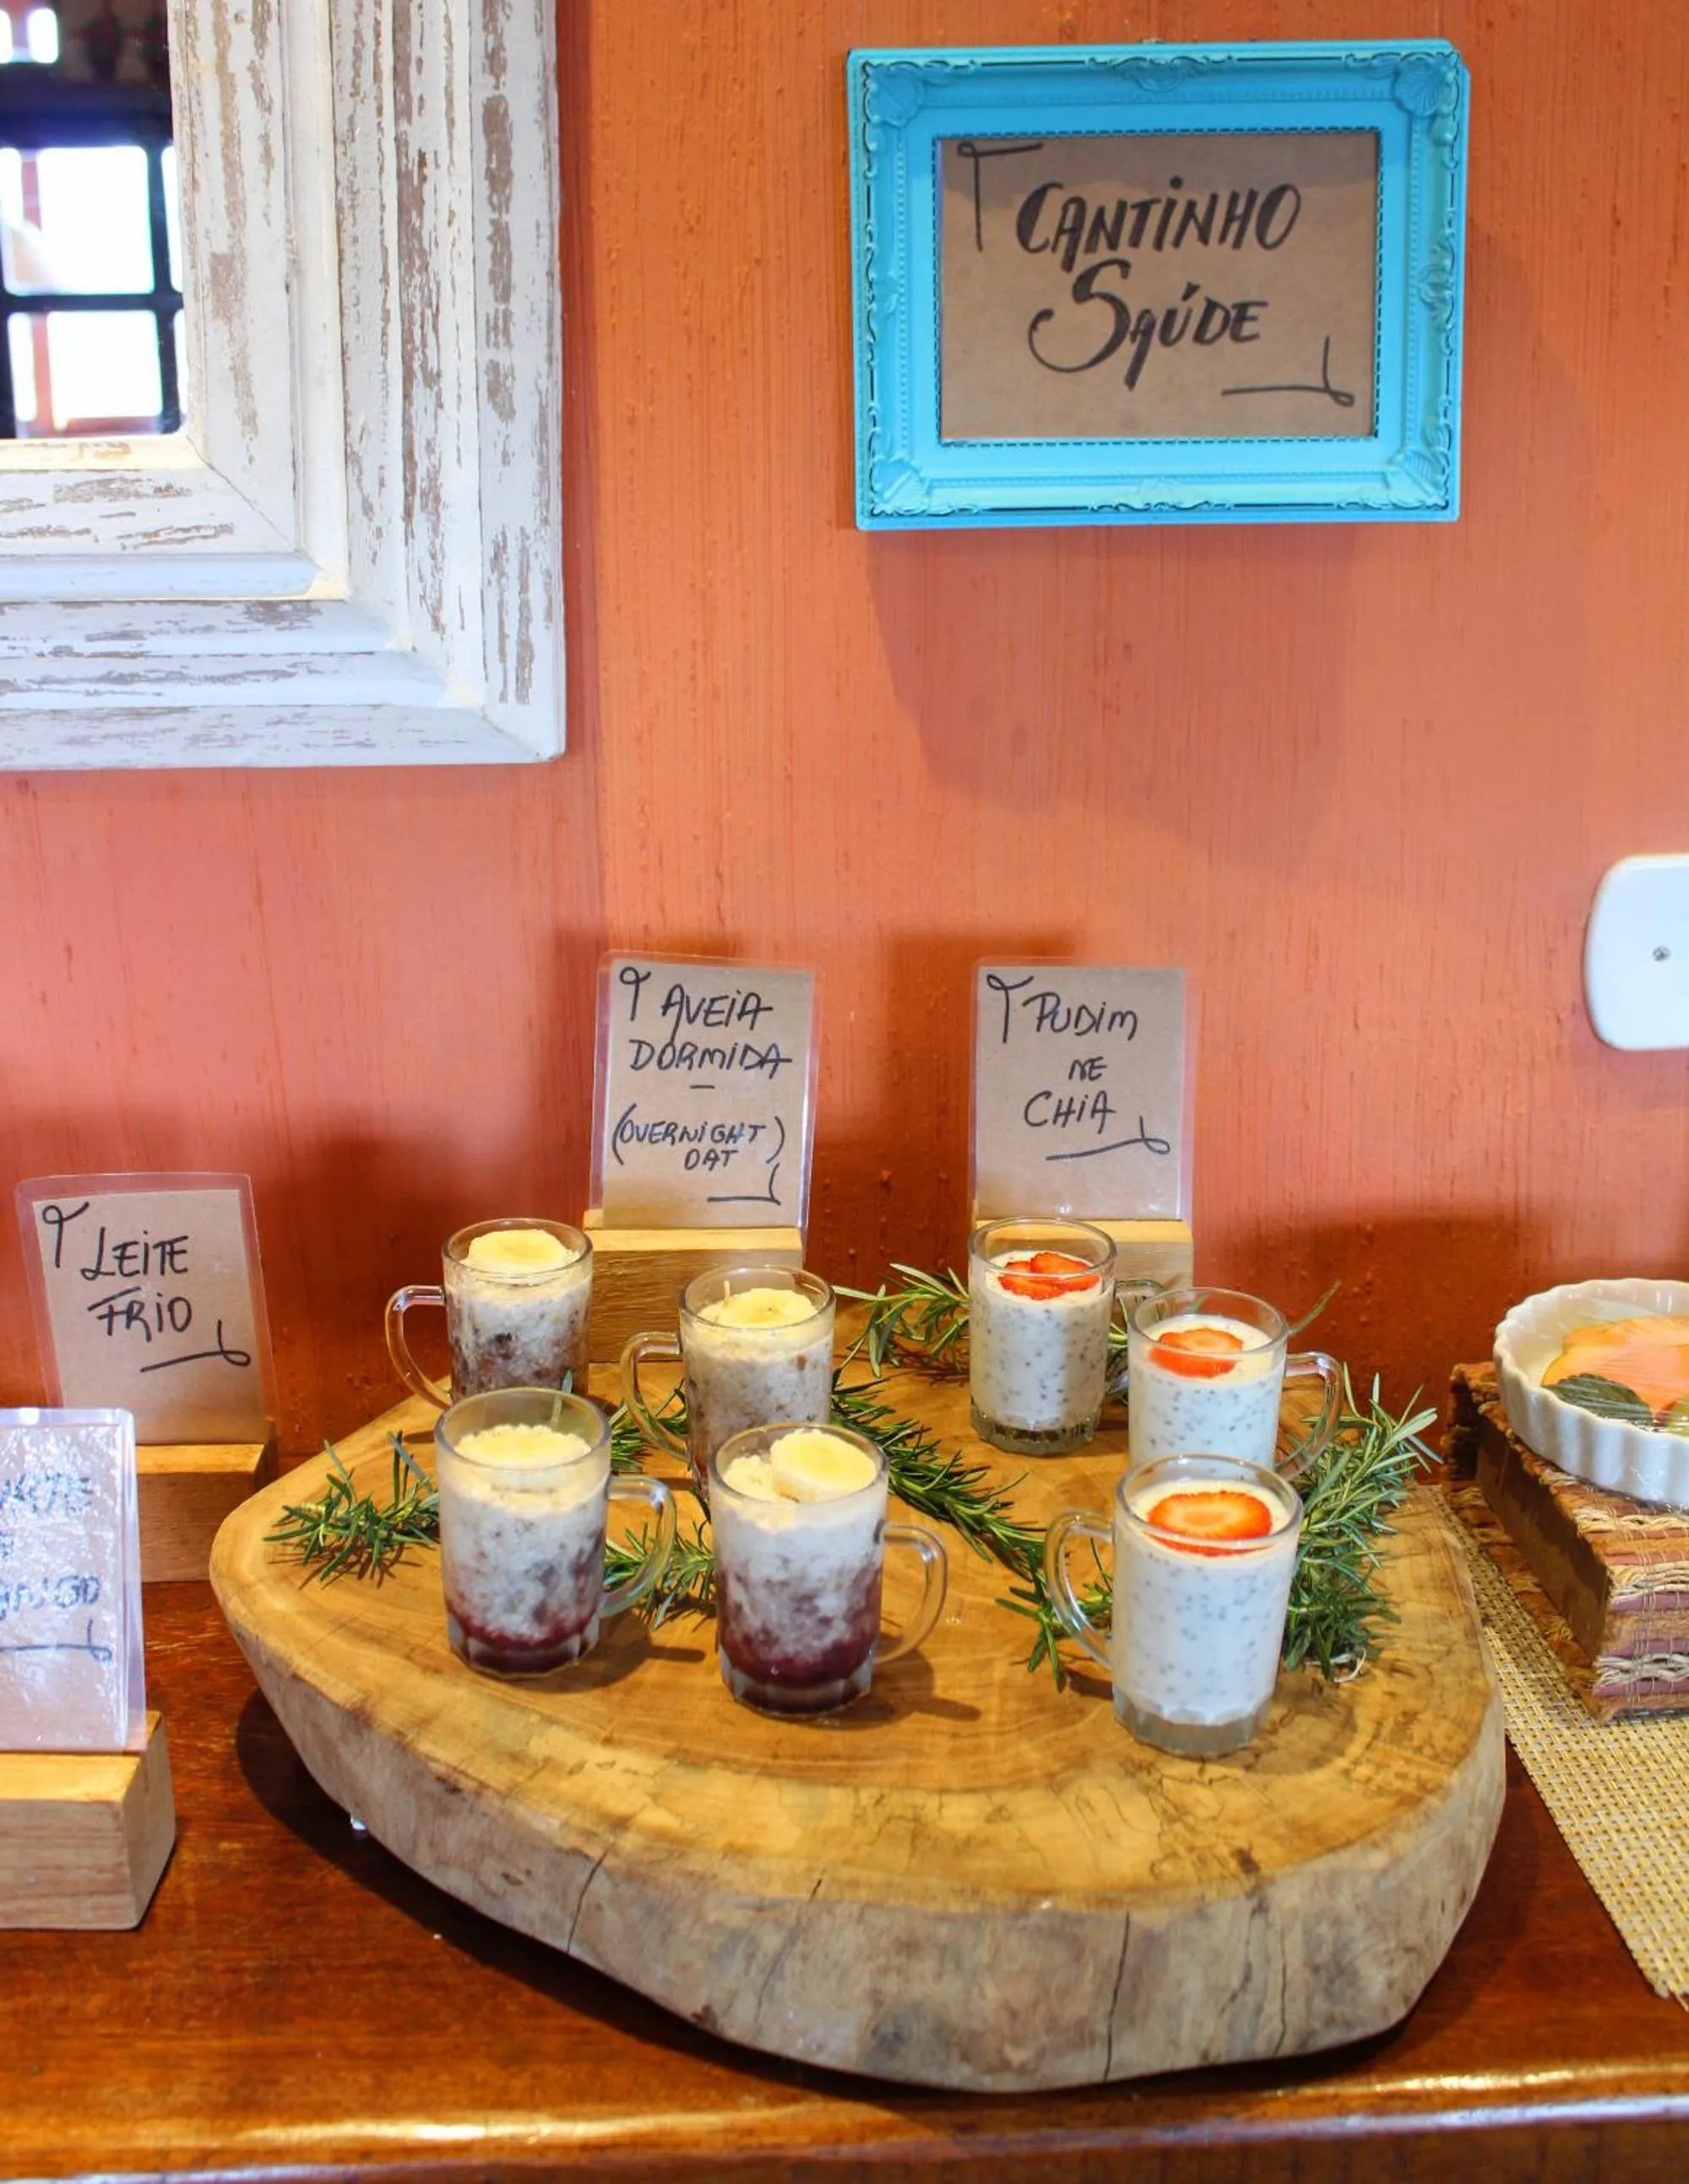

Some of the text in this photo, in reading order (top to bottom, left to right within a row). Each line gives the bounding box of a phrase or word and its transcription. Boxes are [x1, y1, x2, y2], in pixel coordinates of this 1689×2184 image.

[1016, 175, 1301, 273] CANTINHO
[1029, 258, 1268, 391] SAÚDE
[660, 984, 774, 1040] AVEIA
[1022, 991, 1138, 1041] PUDIM
[629, 1040, 792, 1079] DORMIDA
[1024, 1090, 1116, 1134] CHIA
[80, 1226, 188, 1281] LEITE
[87, 1286, 193, 1342] FRIO
